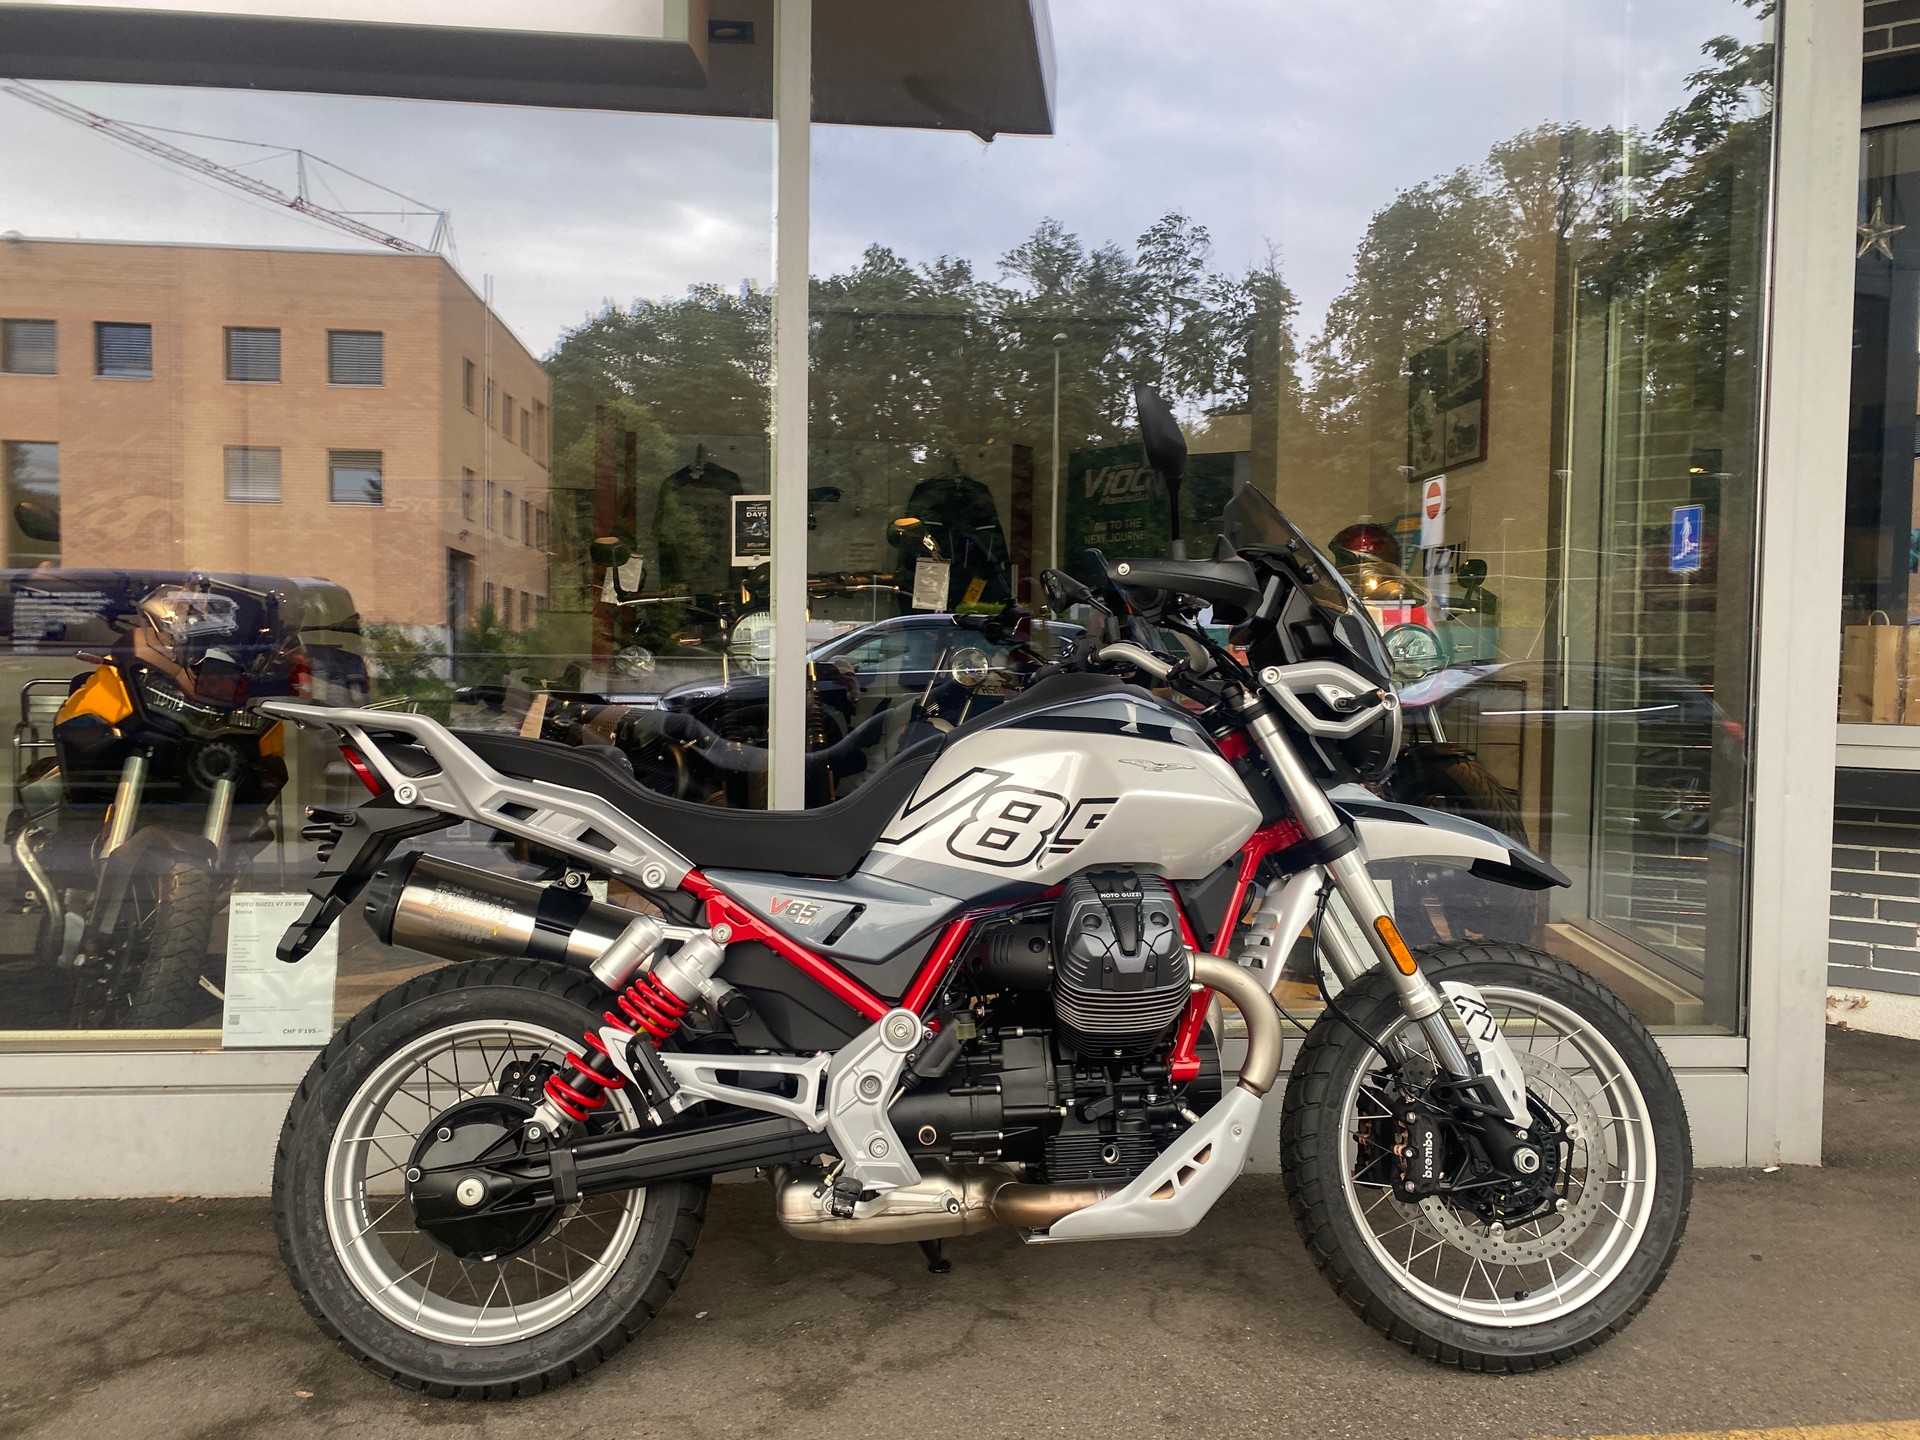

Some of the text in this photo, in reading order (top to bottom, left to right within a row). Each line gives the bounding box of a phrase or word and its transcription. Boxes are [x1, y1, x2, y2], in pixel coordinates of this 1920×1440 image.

[1109, 520, 1122, 530] TO
[1125, 517, 1142, 529] THE
[1084, 533, 1107, 545] NEXT
[769, 896, 824, 918] V85
[1423, 1130, 1434, 1179] brembo
